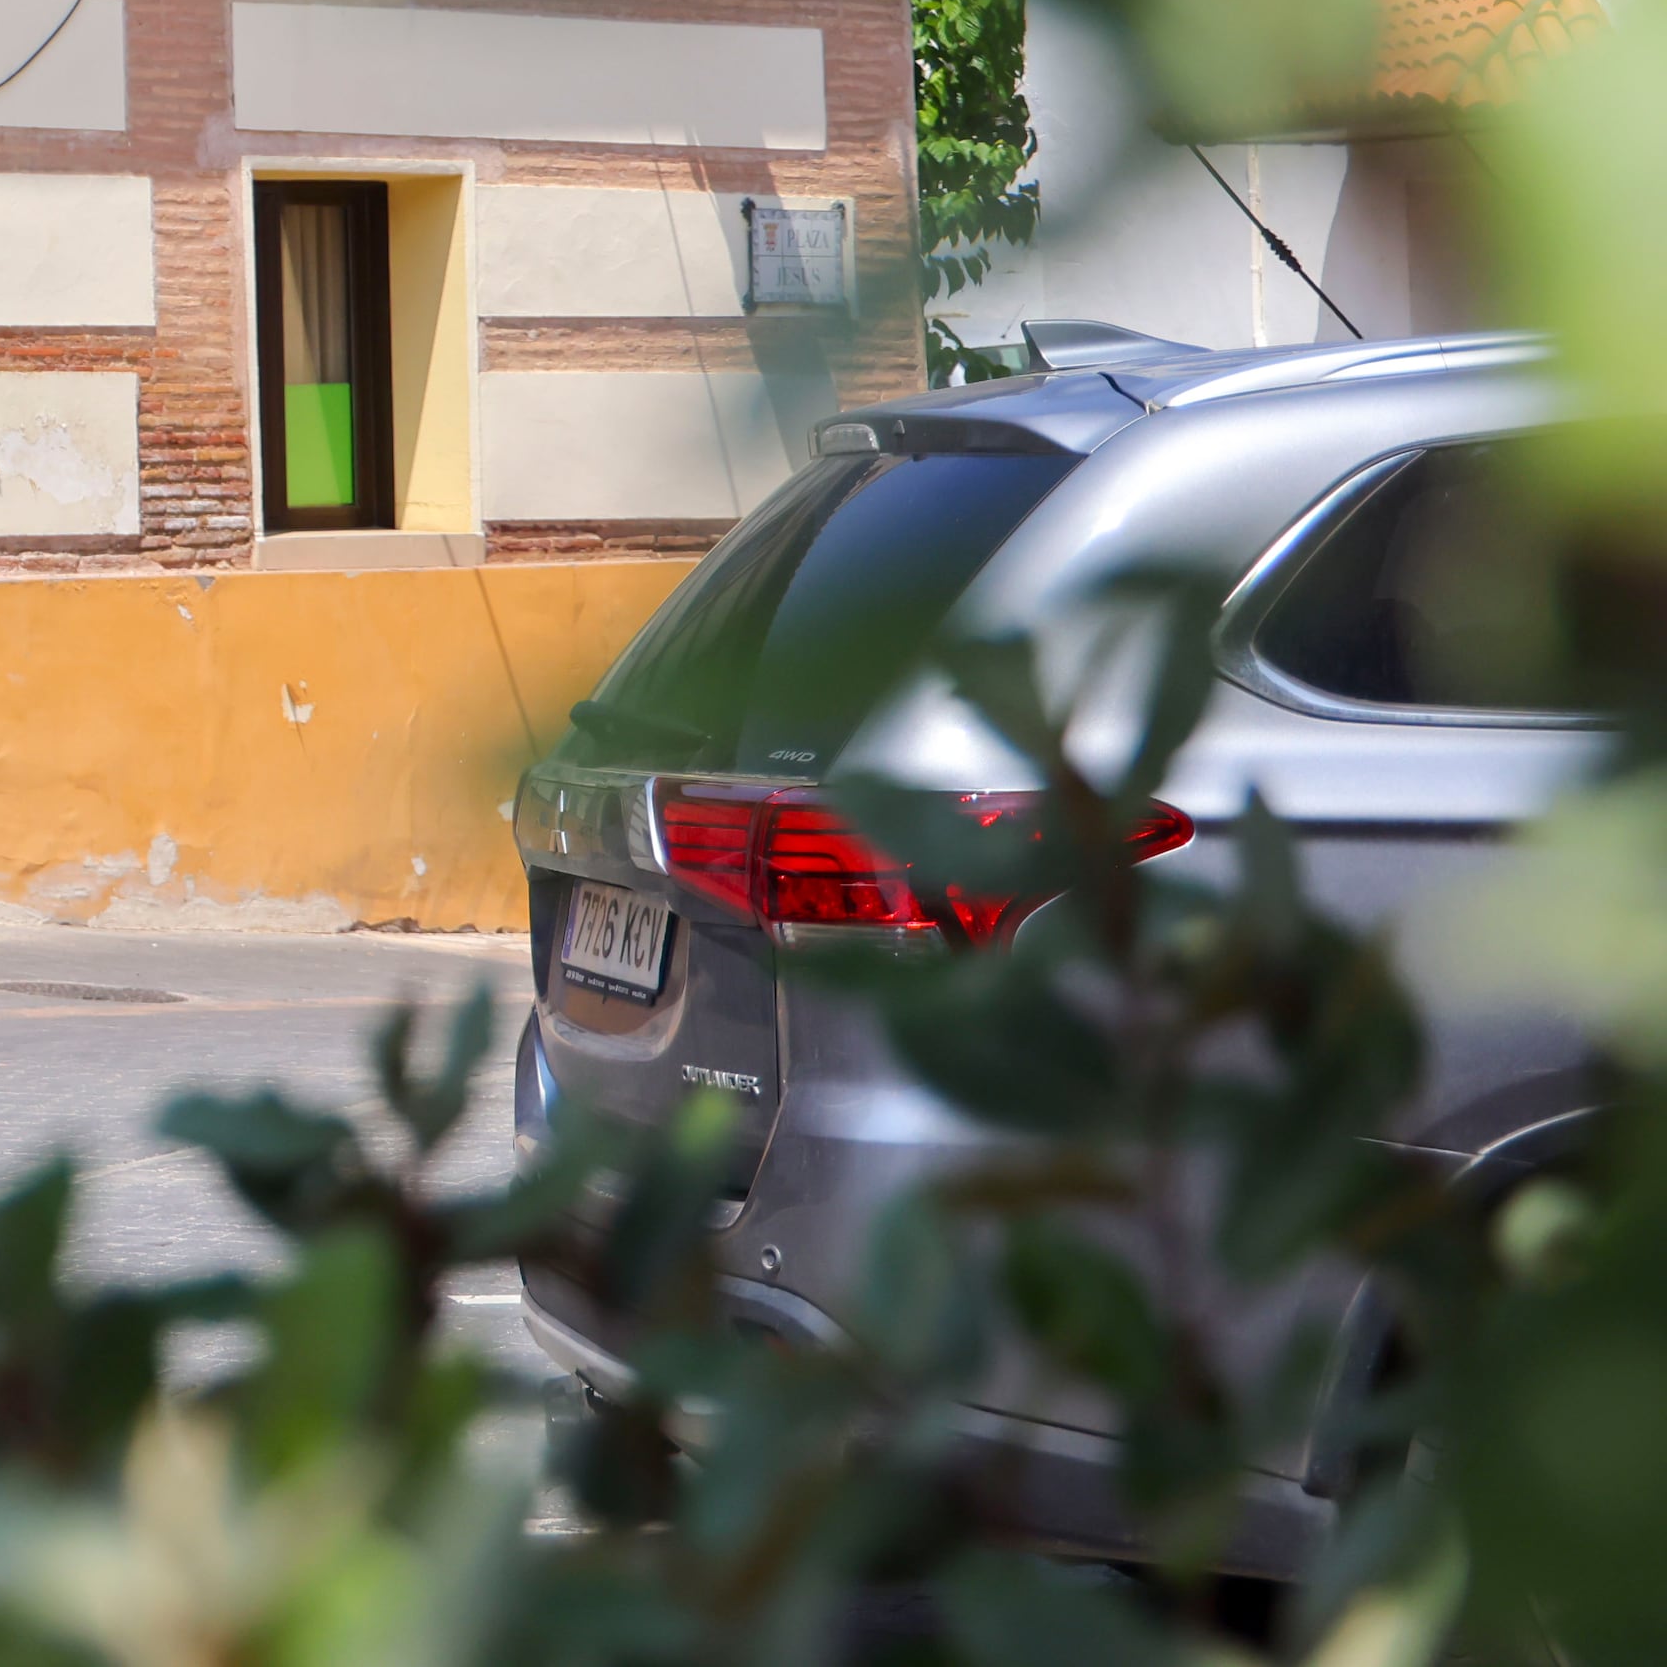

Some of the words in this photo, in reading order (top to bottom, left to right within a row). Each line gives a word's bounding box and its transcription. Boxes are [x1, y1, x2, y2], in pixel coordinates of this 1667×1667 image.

[787, 229, 830, 249] PLAZA
[768, 750, 816, 762] 4WD
[574, 891, 619, 959] 7726
[619, 901, 664, 972] KCV
[682, 1064, 761, 1095] OUTLANDER
